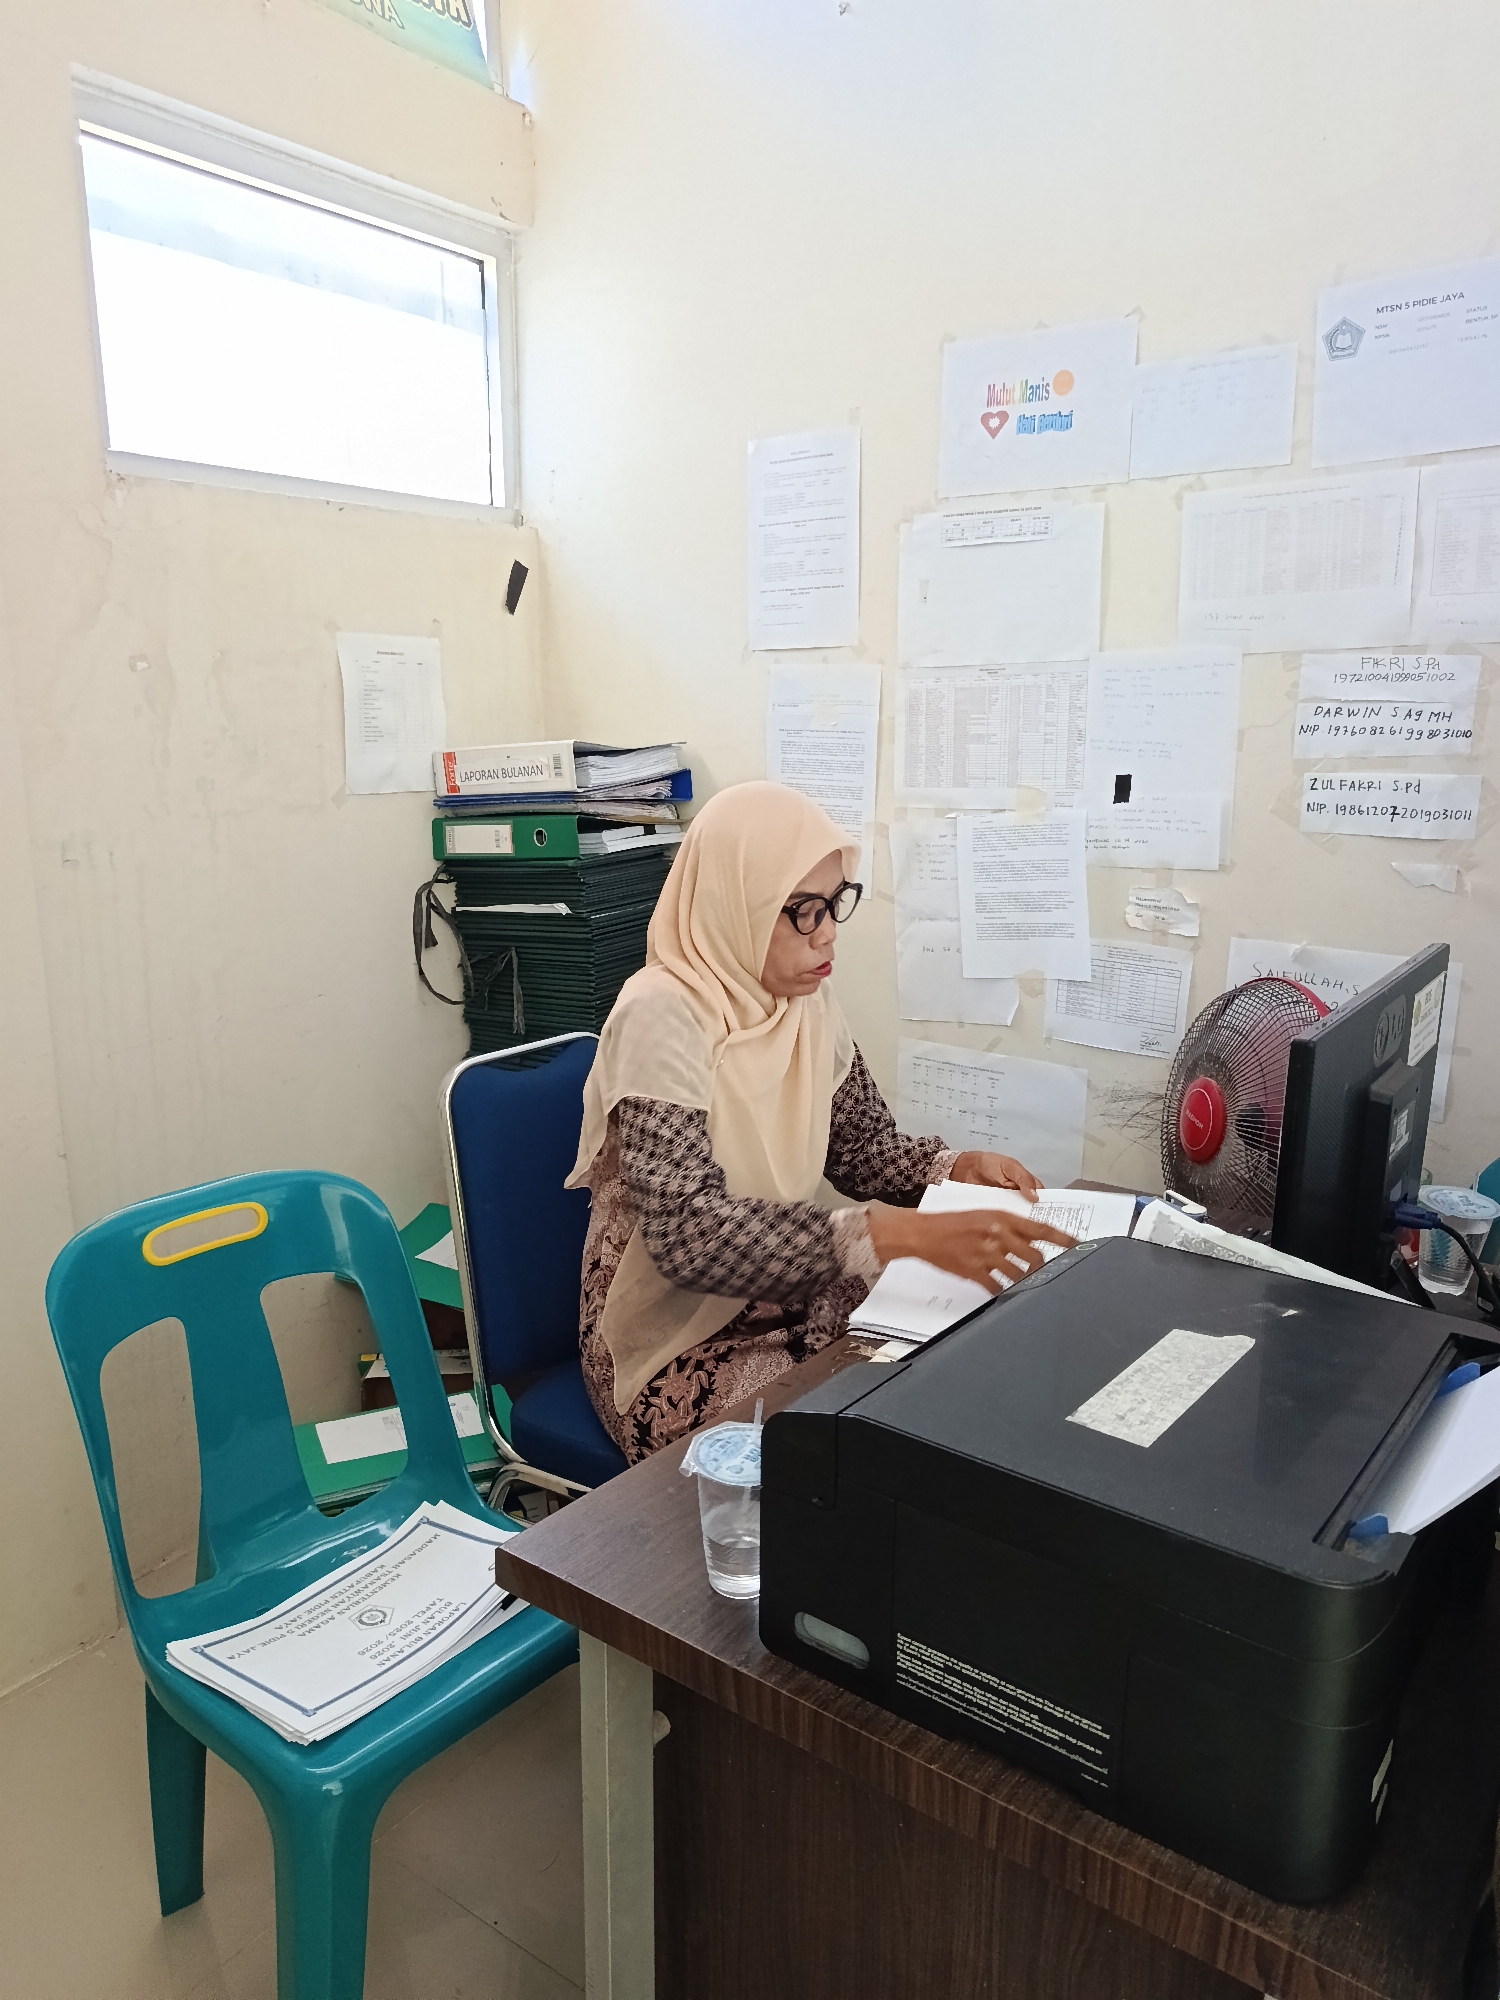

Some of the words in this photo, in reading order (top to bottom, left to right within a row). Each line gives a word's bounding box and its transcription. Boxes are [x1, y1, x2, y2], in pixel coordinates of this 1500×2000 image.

[1376, 303, 1402, 315] MTSN
[1412, 297, 1438, 308] PIDIE
[1439, 291, 1465, 303] JAYA
[986, 382, 1016, 408] Mulut
[1018, 376, 1050, 404] Manis
[1313, 705, 1382, 718] DARWIN
[459, 768, 500, 783] LAPORAN
[501, 765, 544, 779] BULANAN
[1309, 777, 1382, 792] ZULFAKRI
[392, 1533, 440, 1569] MADRASAH
[330, 1564, 386, 1599] KABUPATEN
[331, 1570, 393, 1608] TSANAWIYAH
[337, 1573, 402, 1615] KEMENTERIAN
[303, 1599, 330, 1615] PIDIE
[412, 1598, 444, 1618] TAPEL
[421, 1601, 453, 1625] BULAN
[274, 1614, 302, 1630] JAYA
[294, 1608, 332, 1630] NEGERI
[297, 1615, 335, 1636] AGAMA
[422, 1602, 466, 1636] LAPORAN
[258, 1633, 286, 1647] PIDIE
[399, 1624, 420, 1640] JUNI
[226, 1646, 256, 1660] JAYA
[357, 1639, 383, 1655] 2026
[376, 1636, 423, 1667] BULANAN
